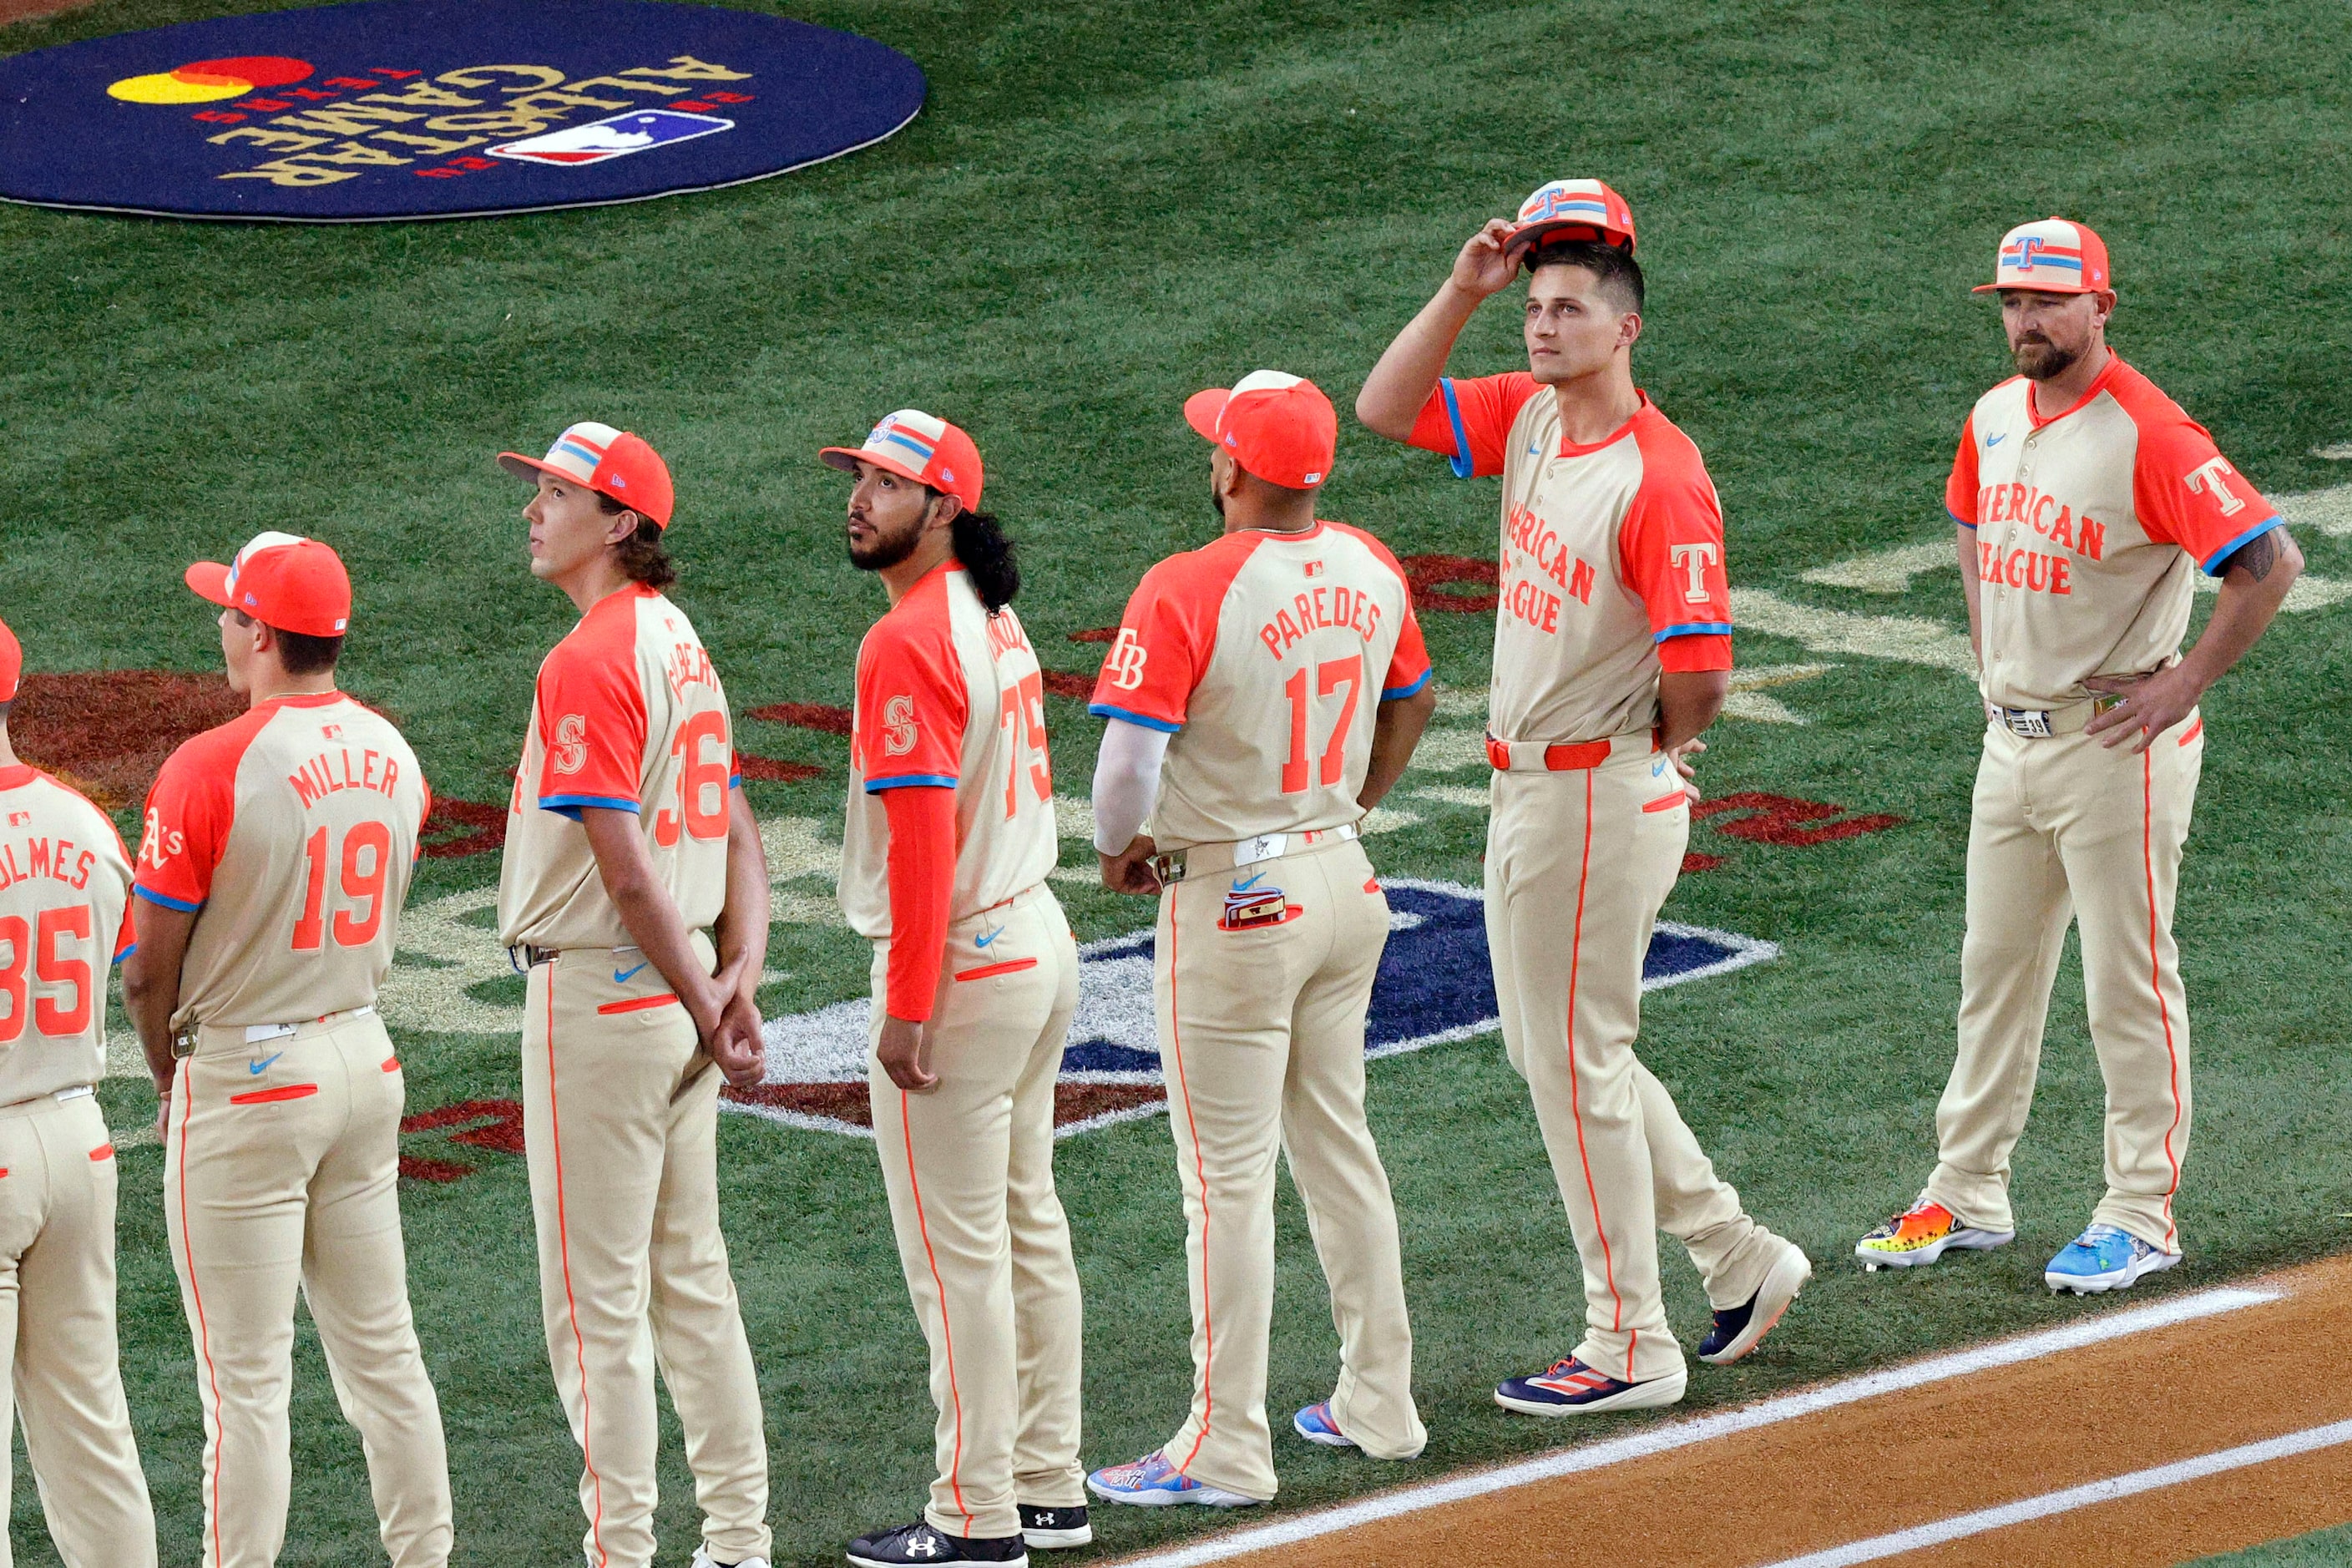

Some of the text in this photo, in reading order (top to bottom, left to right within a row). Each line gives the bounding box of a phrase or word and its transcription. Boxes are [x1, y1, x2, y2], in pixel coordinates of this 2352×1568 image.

[191, 68, 422, 124] TEXAS
[205, 63, 566, 152] GAME
[1535, 187, 1565, 220] T
[2014, 236, 2045, 271] T
[2183, 455, 2246, 517] T
[1670, 542, 1717, 604] T
[1259, 586, 1381, 661] PAREDES
[1105, 628, 1147, 690] TB
[552, 713, 589, 775] S
[883, 695, 920, 757] S
[1000, 670, 1053, 821] 75
[1281, 654, 1363, 796] 17
[288, 748, 398, 811] MILLER
[654, 711, 730, 848] 36
[139, 807, 184, 870] A's
[291, 820, 392, 951] 19
